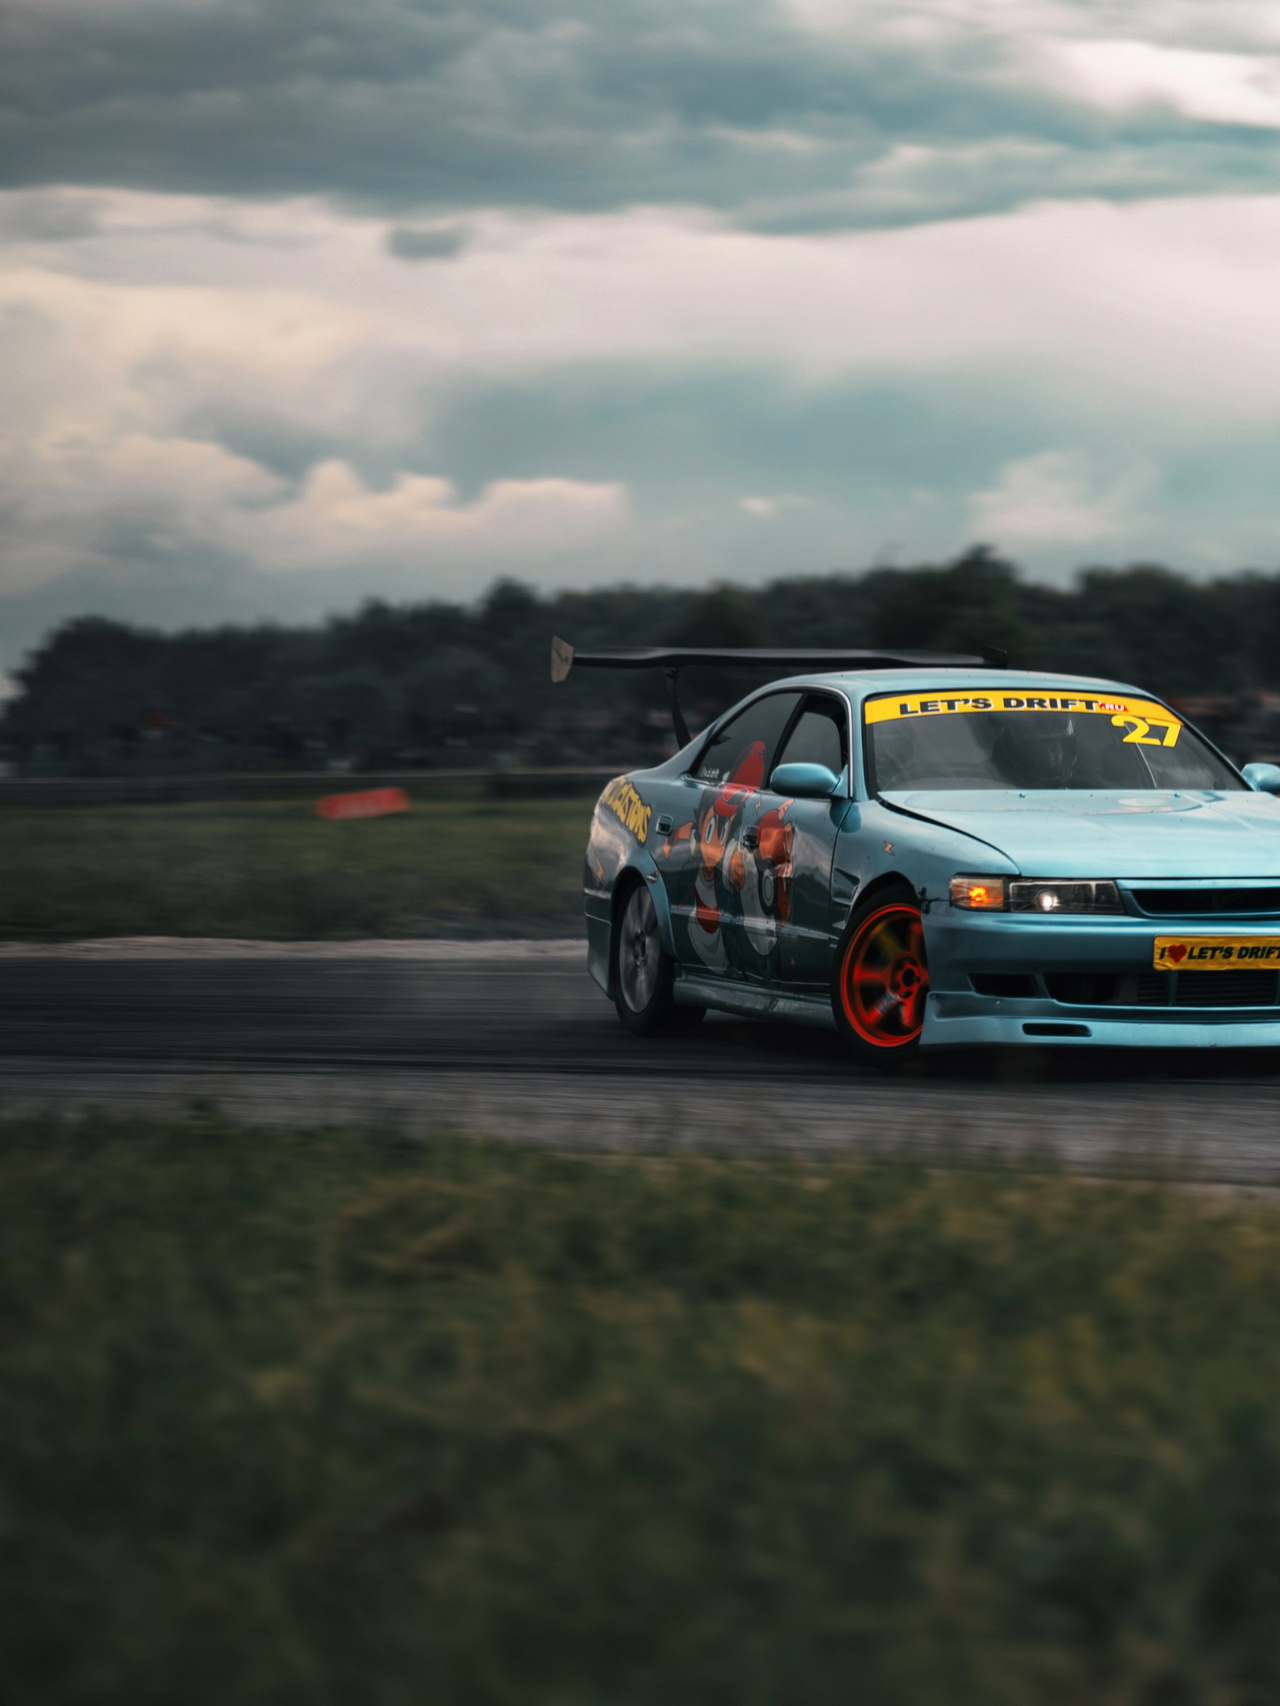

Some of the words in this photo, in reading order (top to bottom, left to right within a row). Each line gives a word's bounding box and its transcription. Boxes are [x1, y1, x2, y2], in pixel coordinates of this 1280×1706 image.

[900, 697, 994, 716] LET'S
[1111, 714, 1182, 748] 27
[1187, 946, 1234, 960] LET'S
